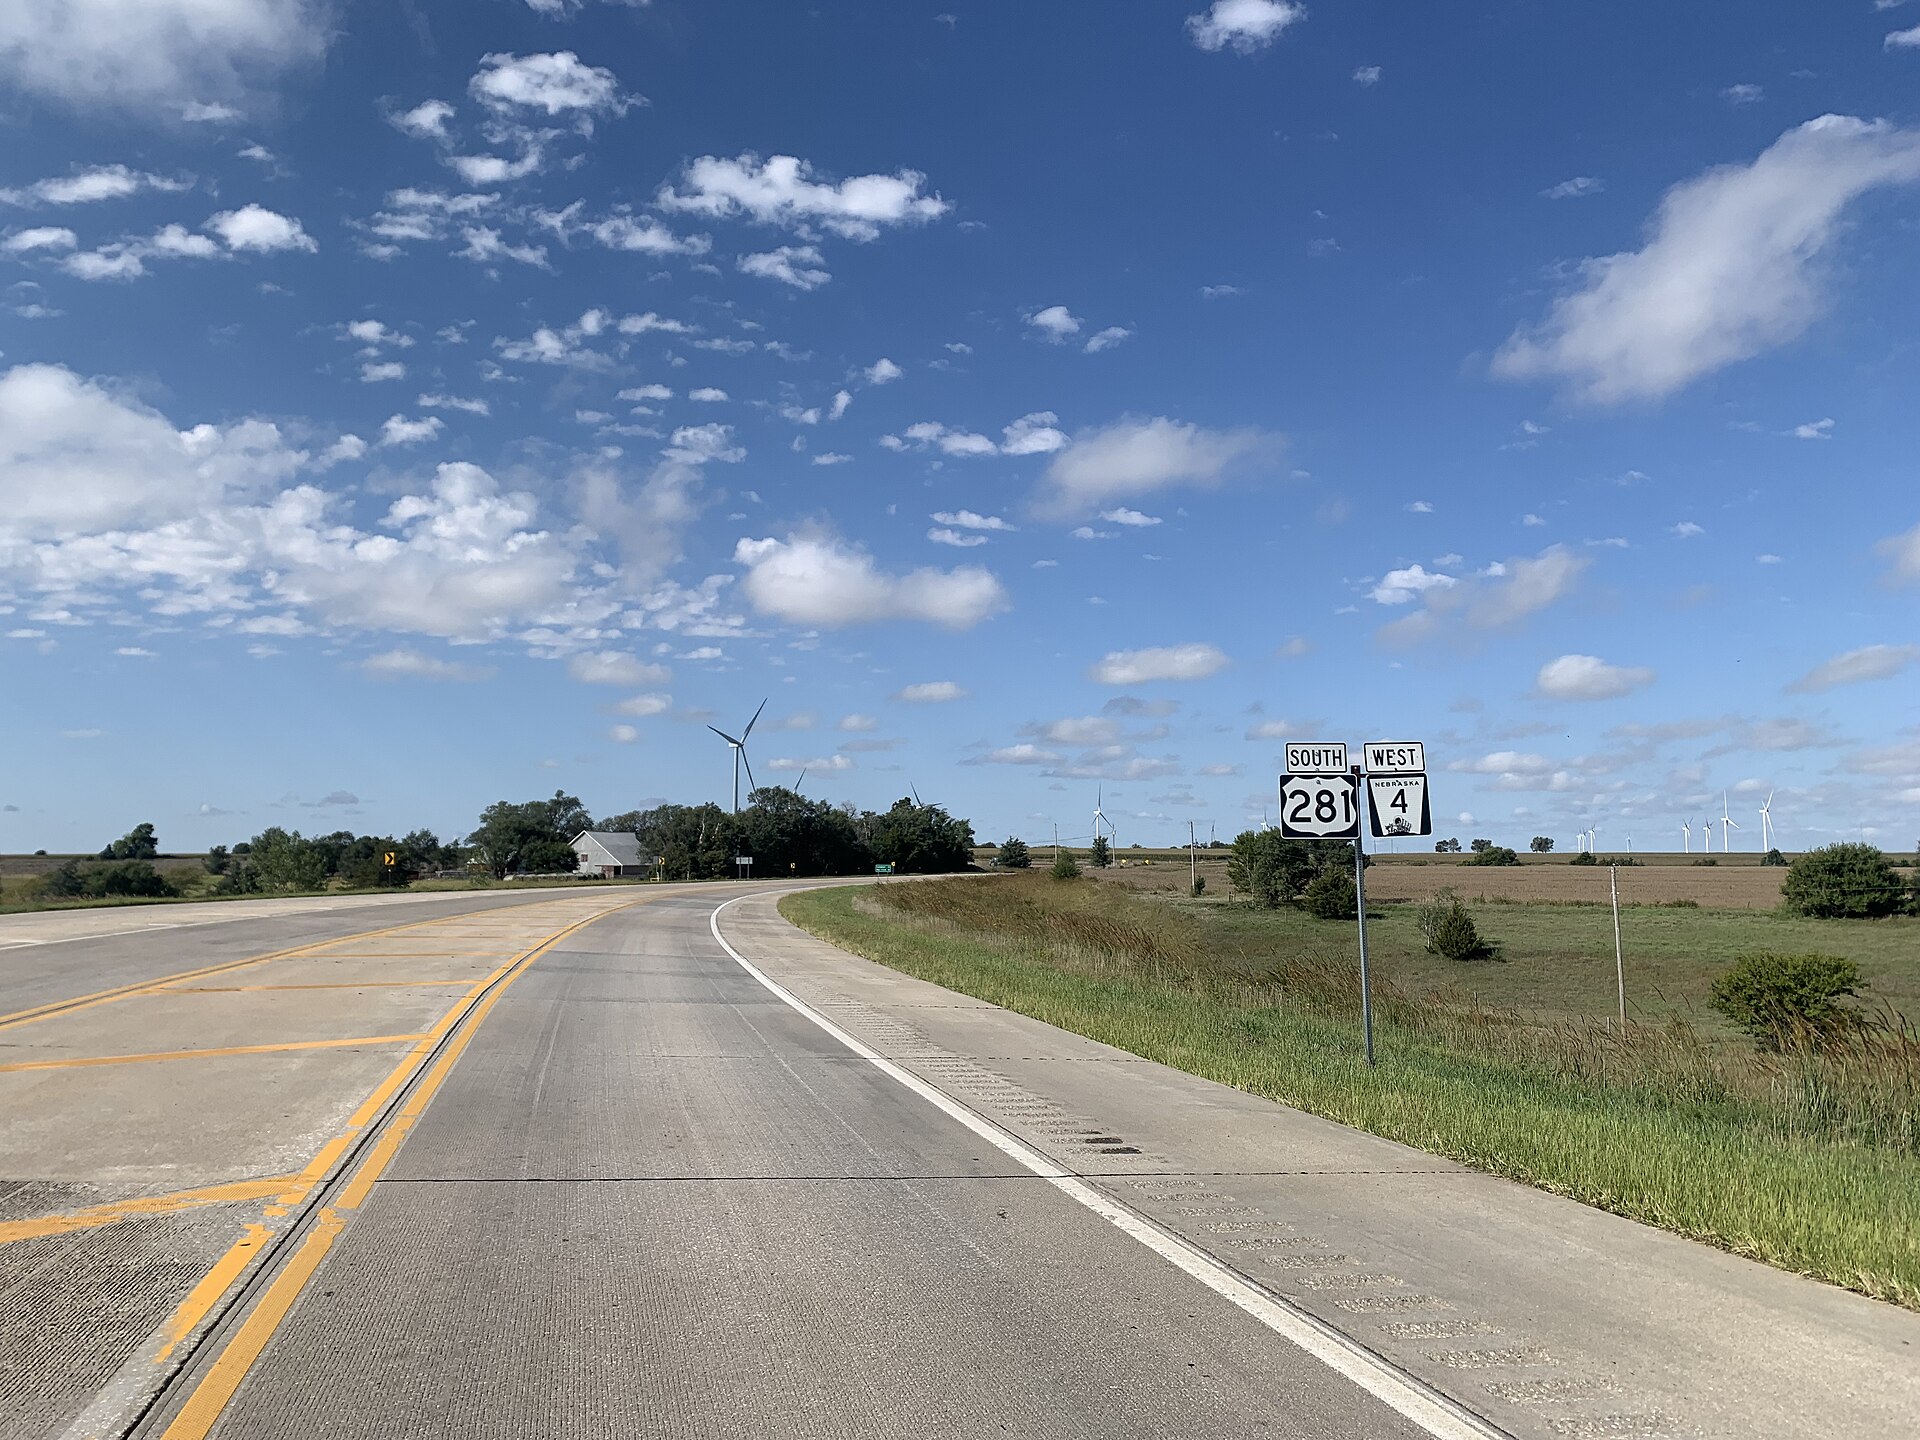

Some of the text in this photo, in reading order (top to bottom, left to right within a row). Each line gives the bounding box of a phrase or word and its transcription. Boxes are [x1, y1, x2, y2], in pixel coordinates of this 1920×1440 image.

[1290, 749, 1342, 767] SOUTH
[1372, 748, 1416, 766] WEST
[1374, 780, 1420, 788] NEBRASKA
[1288, 789, 1351, 823] 281
[1390, 788, 1408, 814] 4
